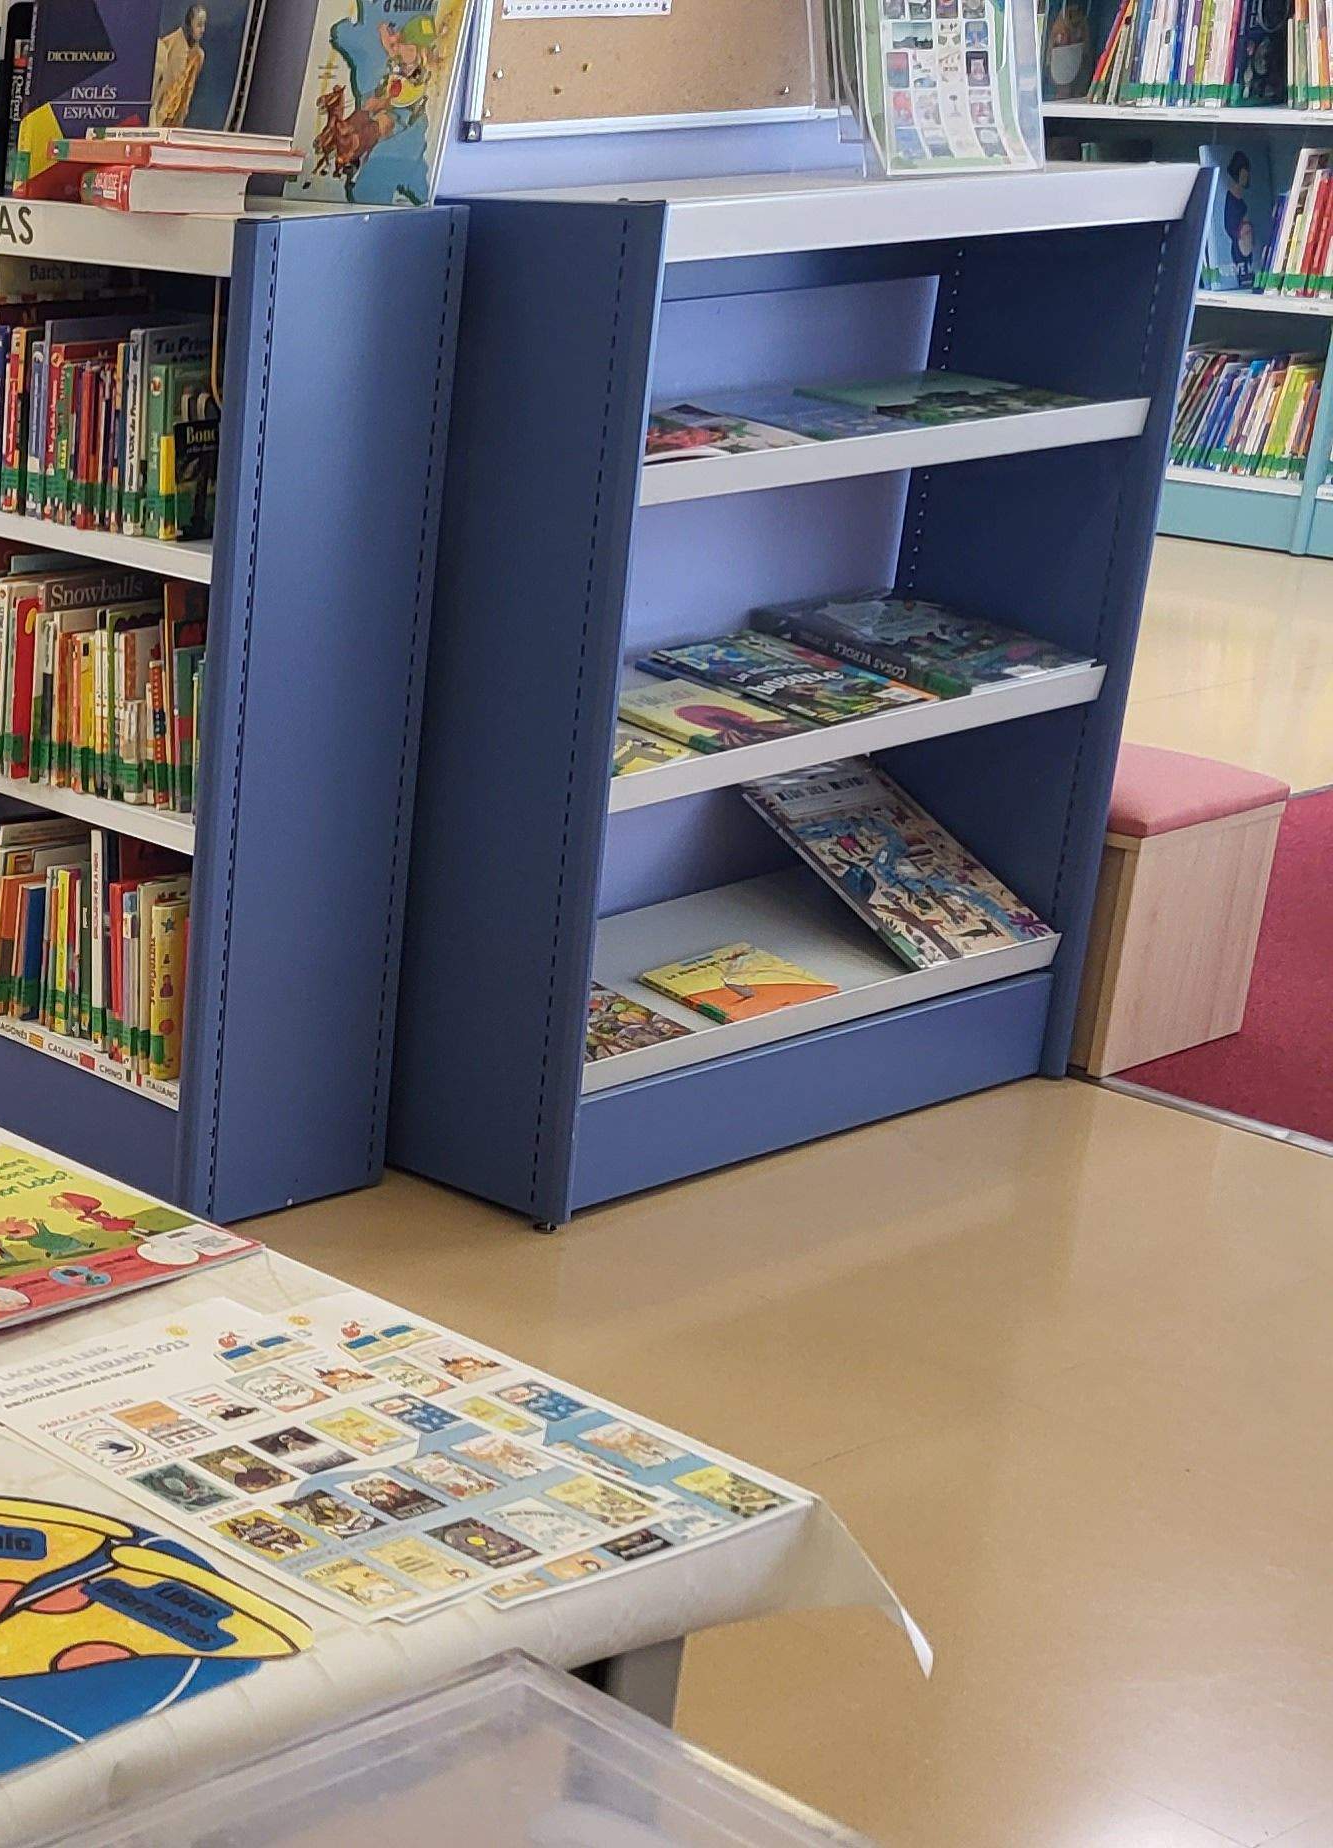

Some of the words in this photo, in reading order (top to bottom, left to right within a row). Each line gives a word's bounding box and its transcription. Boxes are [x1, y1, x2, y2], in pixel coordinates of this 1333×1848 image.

[47, 50, 116, 62] DICCIONARIO
[70, 84, 118, 100] INGLÉS
[63, 105, 119, 121] ESPAÑOL
[47, 1041, 80, 1062] CATALÁN
[99, 1063, 124, 1082] CHINO
[60, 1369, 82, 1383] EN
[84, 1353, 148, 1379] VERANO
[148, 1338, 191, 1357] 2023
[154, 1585, 219, 1620] Libros
